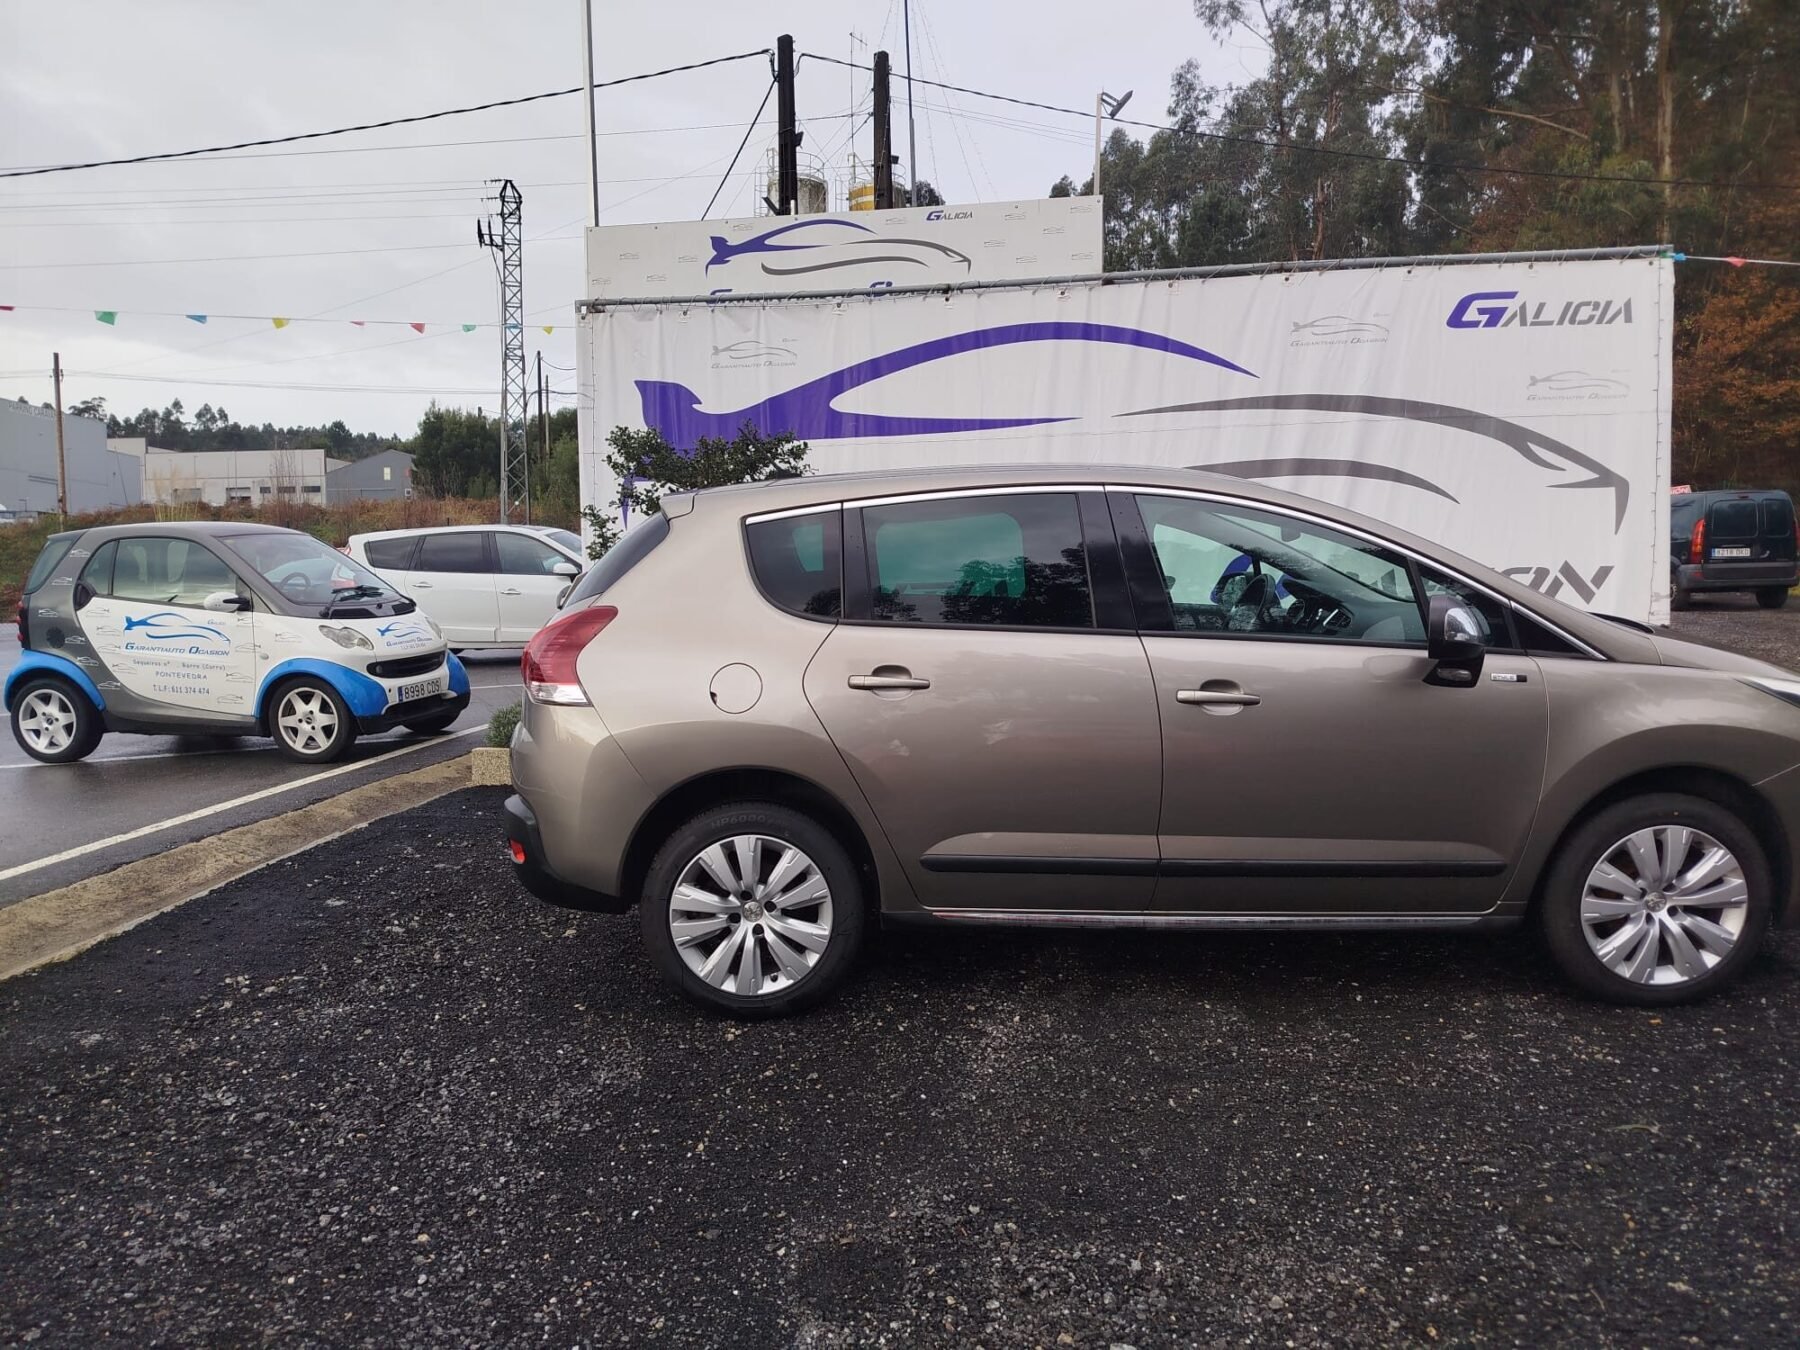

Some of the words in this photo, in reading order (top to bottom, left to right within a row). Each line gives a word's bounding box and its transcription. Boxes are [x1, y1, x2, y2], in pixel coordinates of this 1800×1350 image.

[926, 210, 973, 221] GALICIA
[1446, 290, 1633, 329] GALICIA
[125, 642, 186, 654] GARANTIAUTO
[189, 645, 230, 656] OCASION
[155, 670, 208, 680] PONTEVEDRA
[184, 686, 197, 695] 374
[198, 686, 210, 696] 474
[404, 683, 425, 700] 8998
[426, 680, 440, 693] CDS
